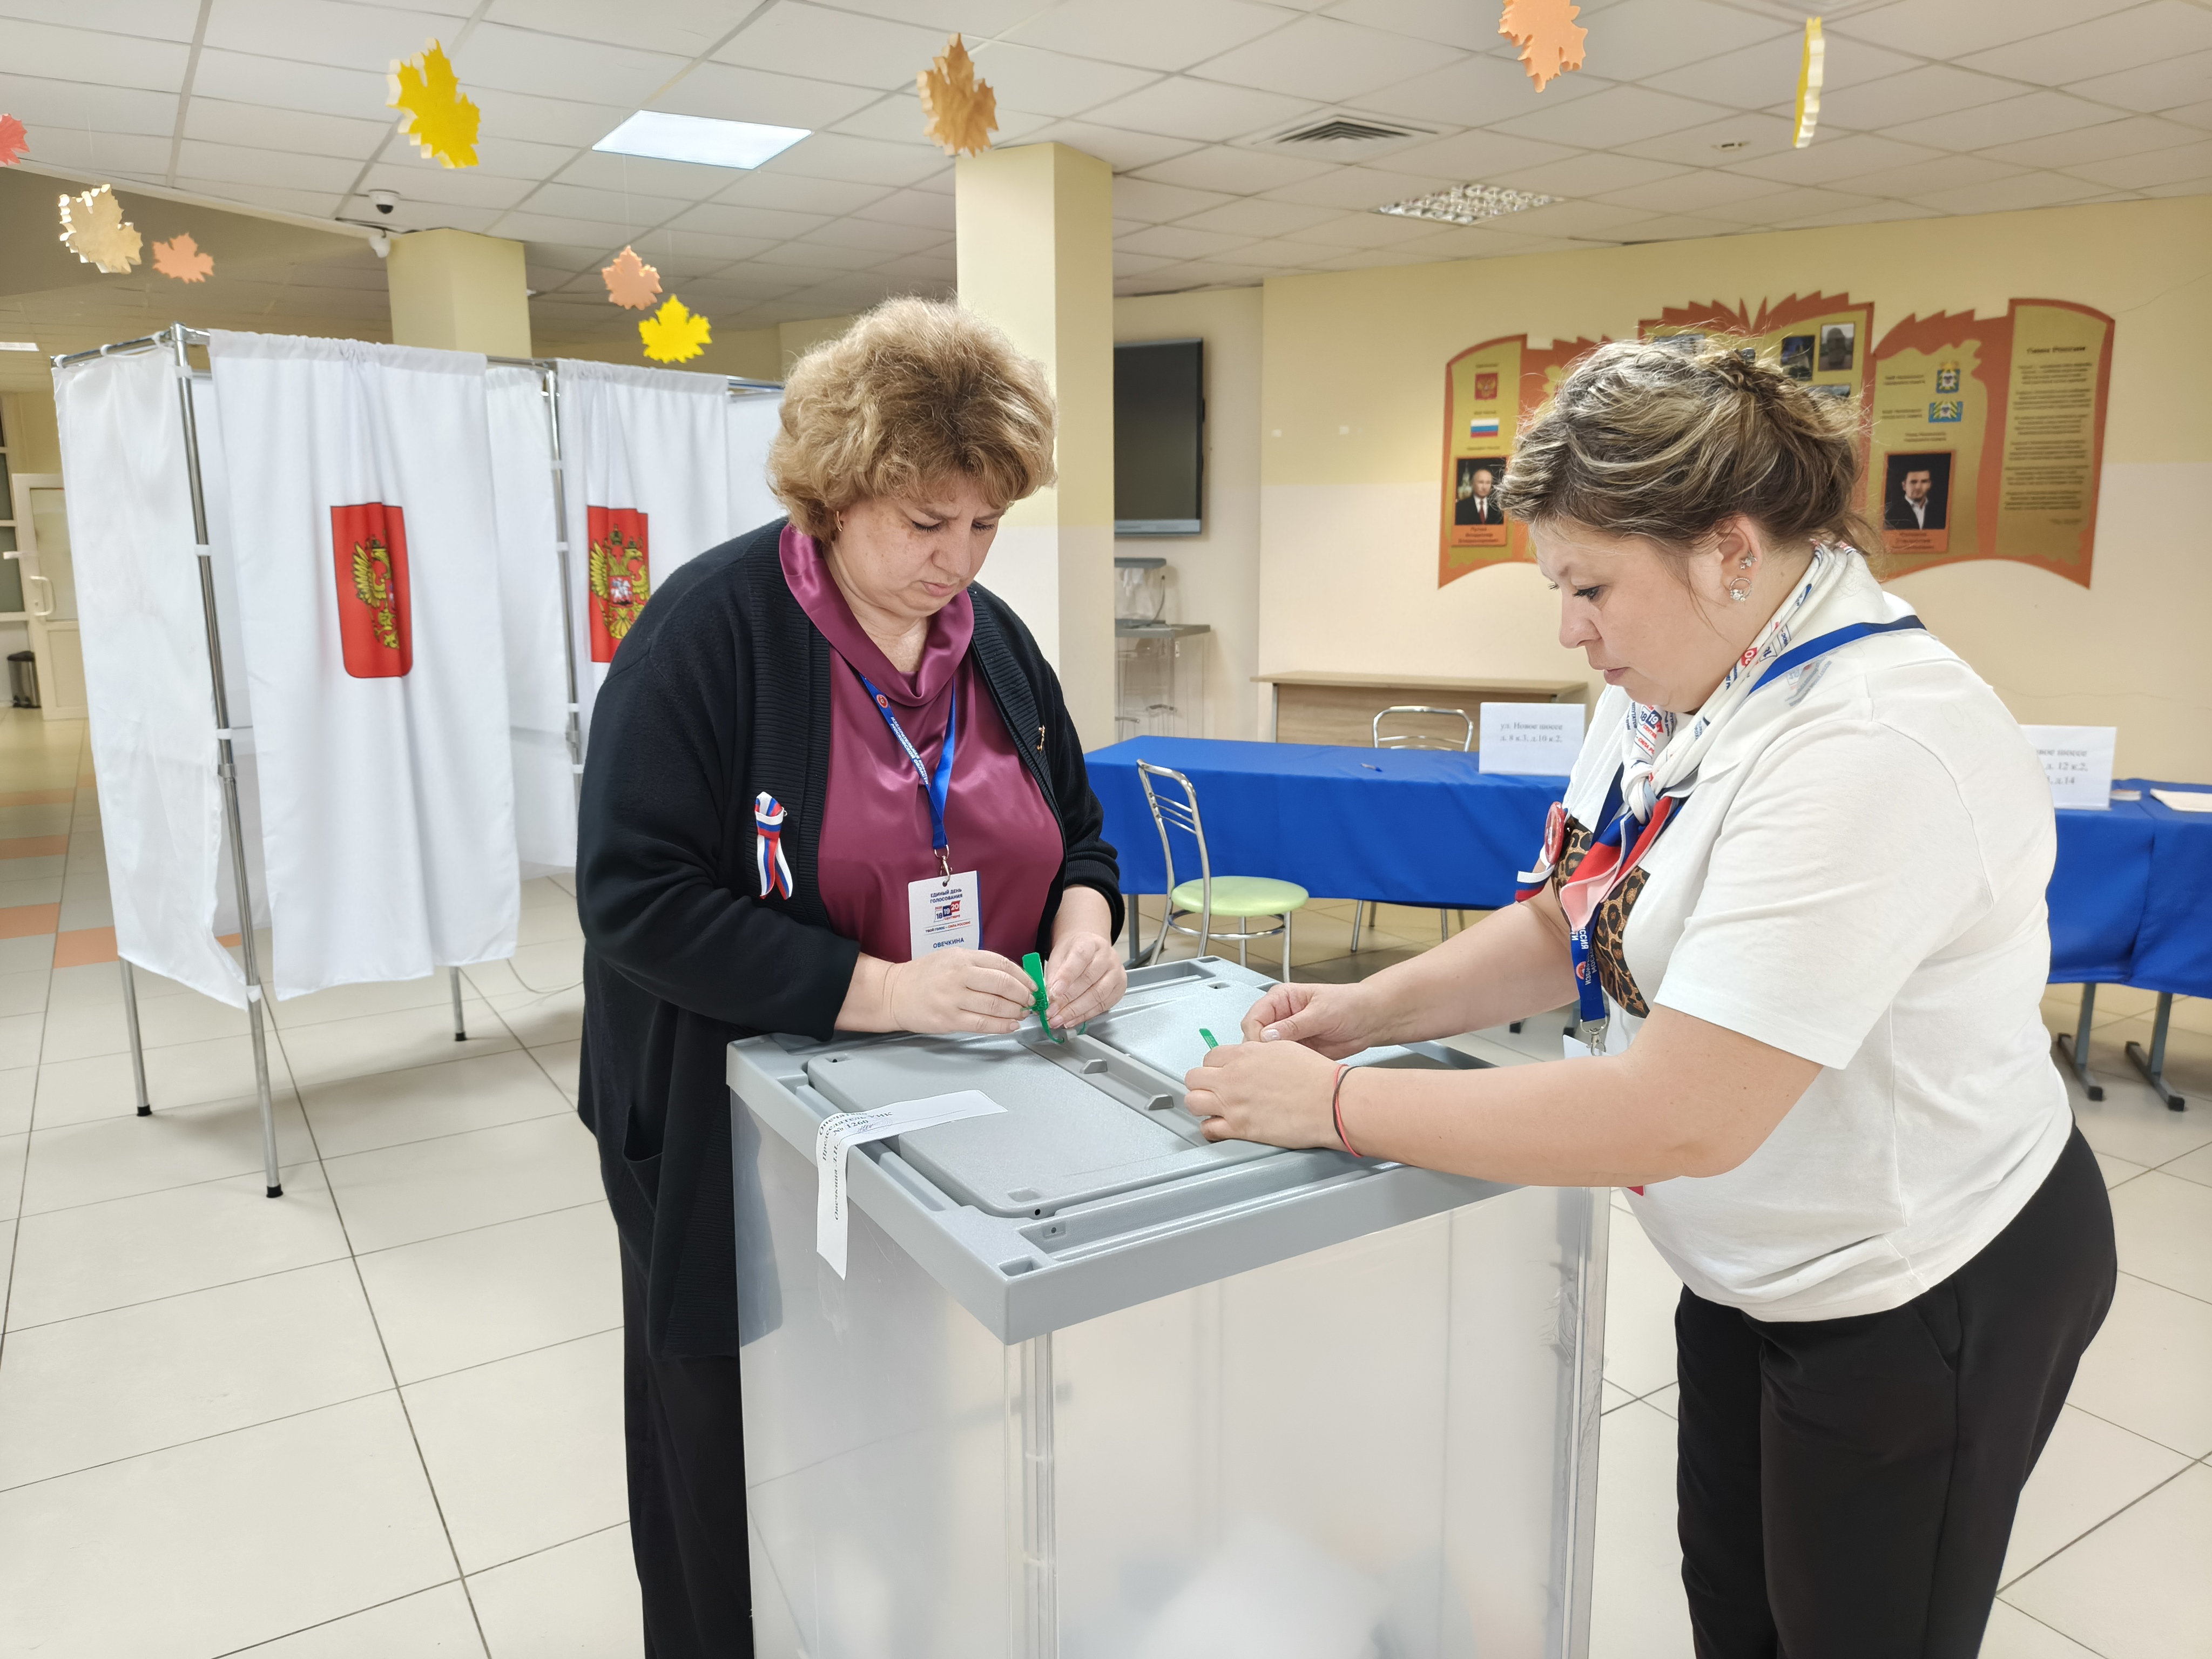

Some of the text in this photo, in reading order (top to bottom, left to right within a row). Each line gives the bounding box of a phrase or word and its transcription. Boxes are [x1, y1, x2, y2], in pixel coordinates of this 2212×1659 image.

[1640, 711, 1648, 721] 18
[1648, 713, 1659, 725] 19
[1500, 723, 1510, 731] ул.
[891, 717, 920, 759] ИЗБИРАТЕЛЬНАЯ
[1638, 737, 1649, 749] СИЛА
[891, 723, 929, 785] МОСКОВСКОЙ ОБЛАСТИ
[2059, 761, 2069, 770] 12
[930, 889, 949, 898] ЕДИНЫЙ
[930, 894, 962, 903] ГОЛОСОВАНИЯ
[933, 938, 964, 948] ОВЕЧКИНА
[1579, 927, 1589, 949] ССИЯ
[819, 1112, 868, 1135] Опечатано
[833, 1127, 844, 1137] №
[846, 1120, 869, 1128] 1260
[822, 1115, 866, 1161] Председатель
